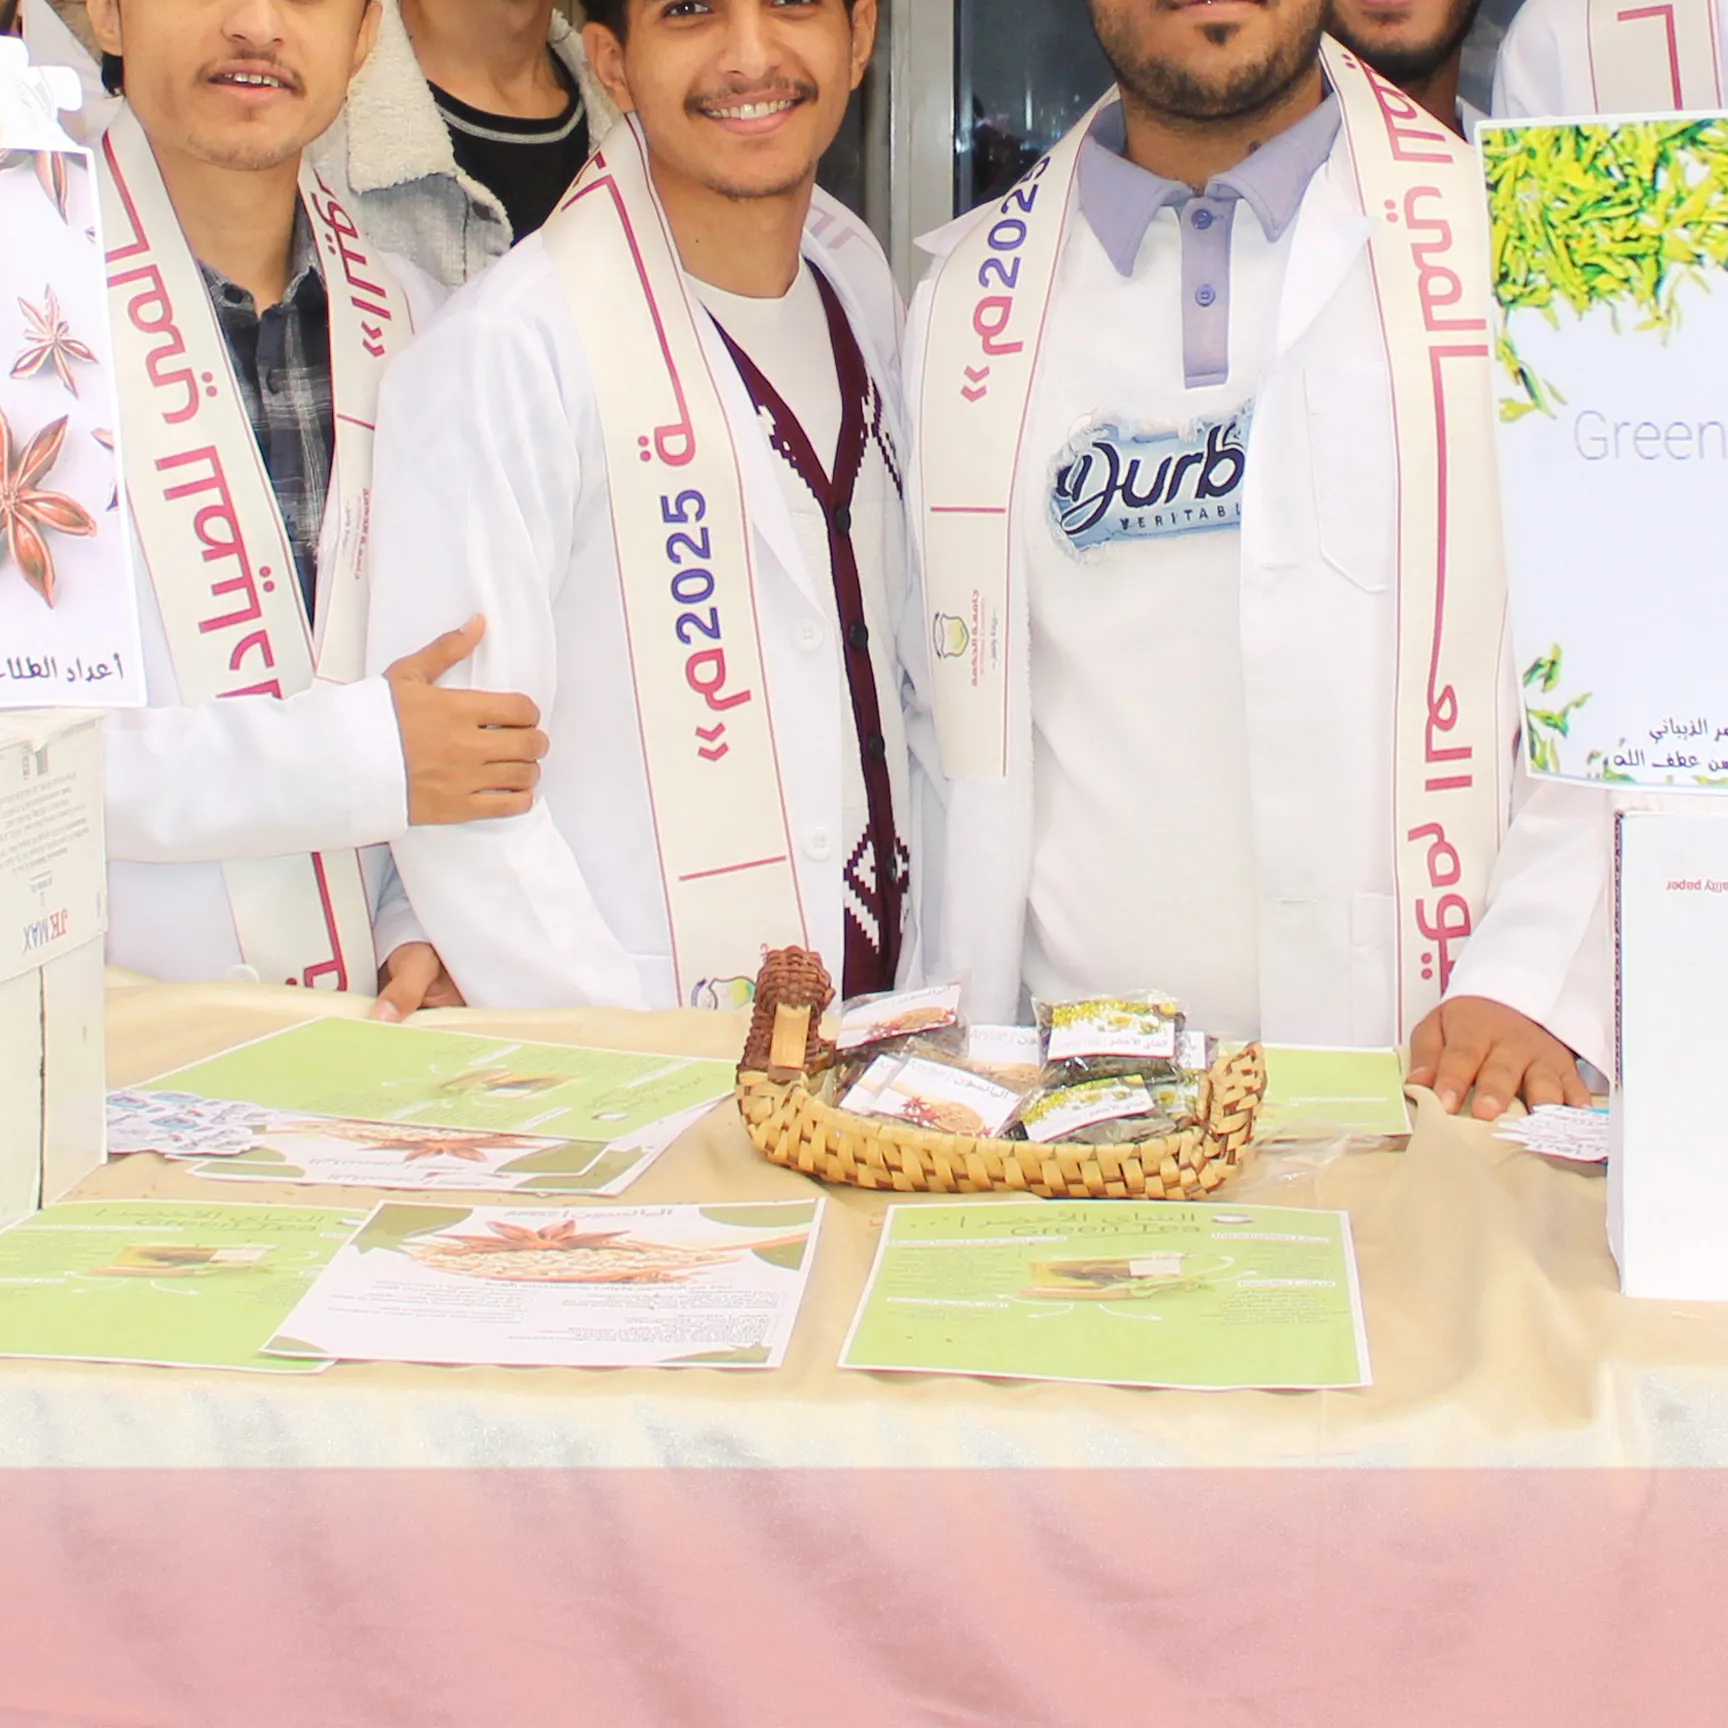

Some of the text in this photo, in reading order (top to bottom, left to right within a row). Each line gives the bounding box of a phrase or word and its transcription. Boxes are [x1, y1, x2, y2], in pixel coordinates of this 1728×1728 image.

[1574, 408, 1728, 461] Green
[1613, 748, 1646, 768] الله
[1666, 879, 1703, 892] paper
